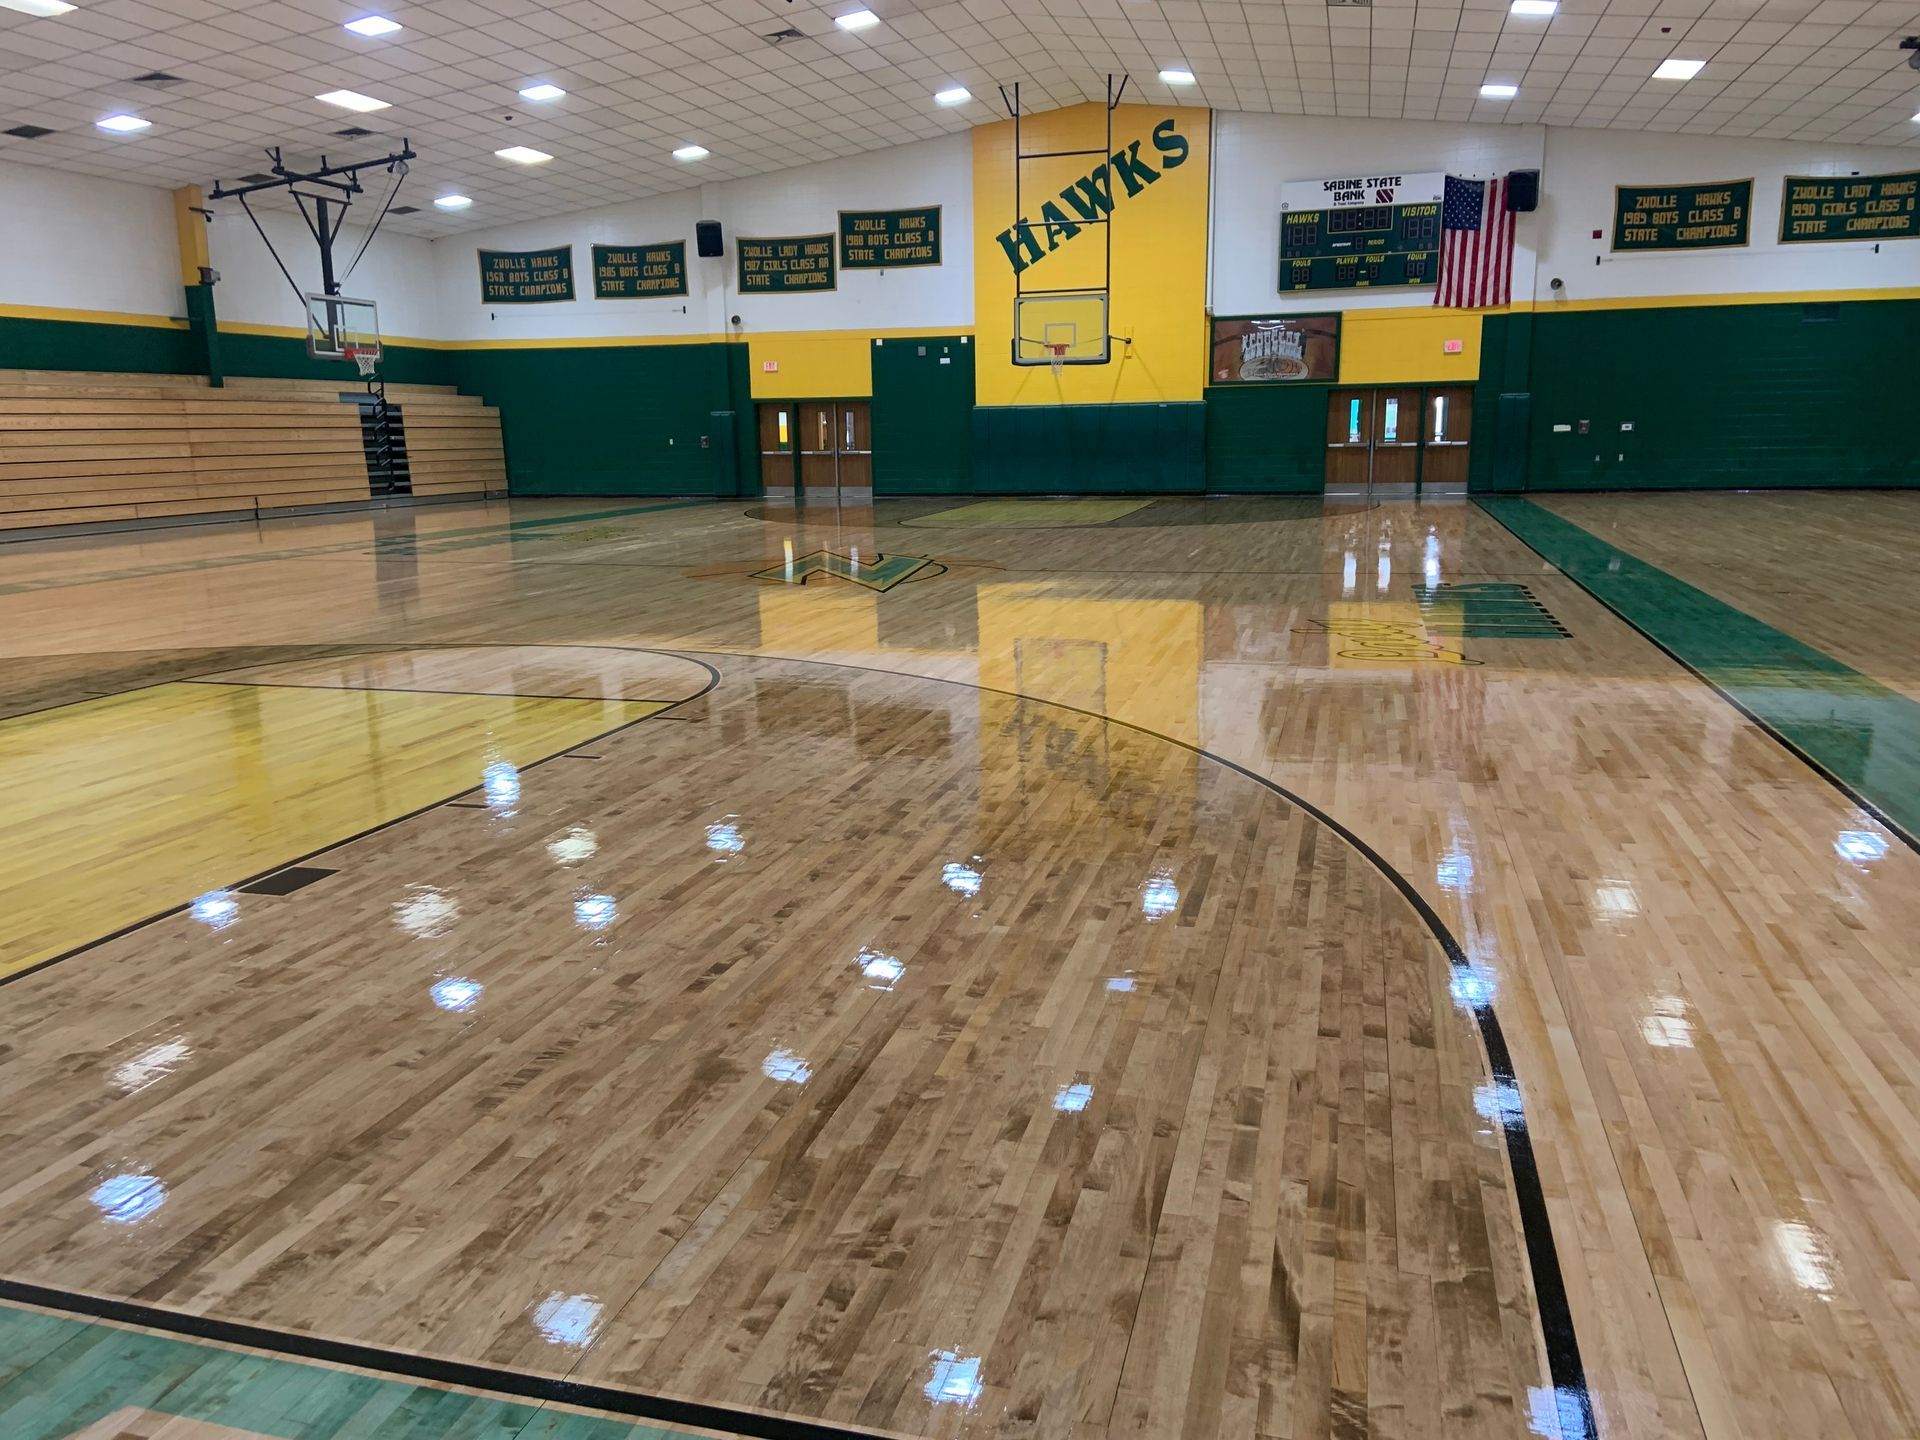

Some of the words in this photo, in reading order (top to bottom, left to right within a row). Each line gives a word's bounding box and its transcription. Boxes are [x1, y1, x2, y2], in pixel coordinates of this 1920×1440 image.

[1323, 178, 1363, 191] SABINE
[1366, 176, 1401, 188] STATE
[1792, 186, 1835, 200] ZWOLLE
[1844, 184, 1872, 198] LADY
[1880, 181, 1917, 196] HAWKS
[995, 119, 1189, 275] HAWKS
[1333, 190, 1366, 201] BANK
[1636, 195, 1678, 209] ZWOLLE
[1695, 192, 1731, 206] HAWKS
[1402, 205, 1437, 216] VISITOR
[1792, 203, 1816, 216] 1990
[1822, 201, 1857, 215] GIRLS
[1865, 199, 1901, 213] CLASS
[1287, 214, 1320, 224] HAWKS
[1623, 211, 1647, 225] 1989
[1652, 211, 1679, 224] BOYS
[1688, 208, 1725, 224] CLASS
[1734, 206, 1742, 220] B
[854, 219, 886, 231] ZWOLLE
[899, 216, 926, 229] HAWKS
[1792, 220, 1827, 234] STATE
[1846, 215, 1910, 231] CHAMPIONS
[846, 234, 864, 246] 1988
[868, 234, 889, 245] BOYS
[894, 232, 921, 244] CLASS
[1624, 228, 1659, 241] STATE
[1676, 224, 1738, 240] CHAMPIONS
[607, 252, 638, 264] ZWOLLE
[646, 250, 671, 262] HAWKS
[743, 246, 772, 257] ZWOLLE
[778, 245, 798, 256] LADY
[805, 243, 829, 255] HAWKS
[848, 249, 875, 260] STATE
[884, 246, 932, 260] CHAMPIONS
[1407, 252, 1427, 260] FOULS
[492, 257, 526, 269] ZWOLLE
[530, 256, 559, 268] HAWKS
[763, 259, 787, 271] GIRLS
[790, 258, 815, 270] CLASS
[1292, 259, 1312, 267] FOULS
[1335, 256, 1359, 265] PLAYER
[1365, 255, 1385, 263] FOULS
[509, 271, 530, 282] BOYS
[533, 269, 558, 282] CLASS
[619, 266, 639, 277] BOYS
[643, 264, 667, 276] CLASS
[601, 280, 624, 291] STATE
[636, 277, 679, 290] CHAMPIONS
[746, 274, 770, 286] STATE
[784, 272, 827, 284] CHAMPIONS
[488, 285, 515, 296] STATE
[520, 283, 567, 296] CHAMPIONS
